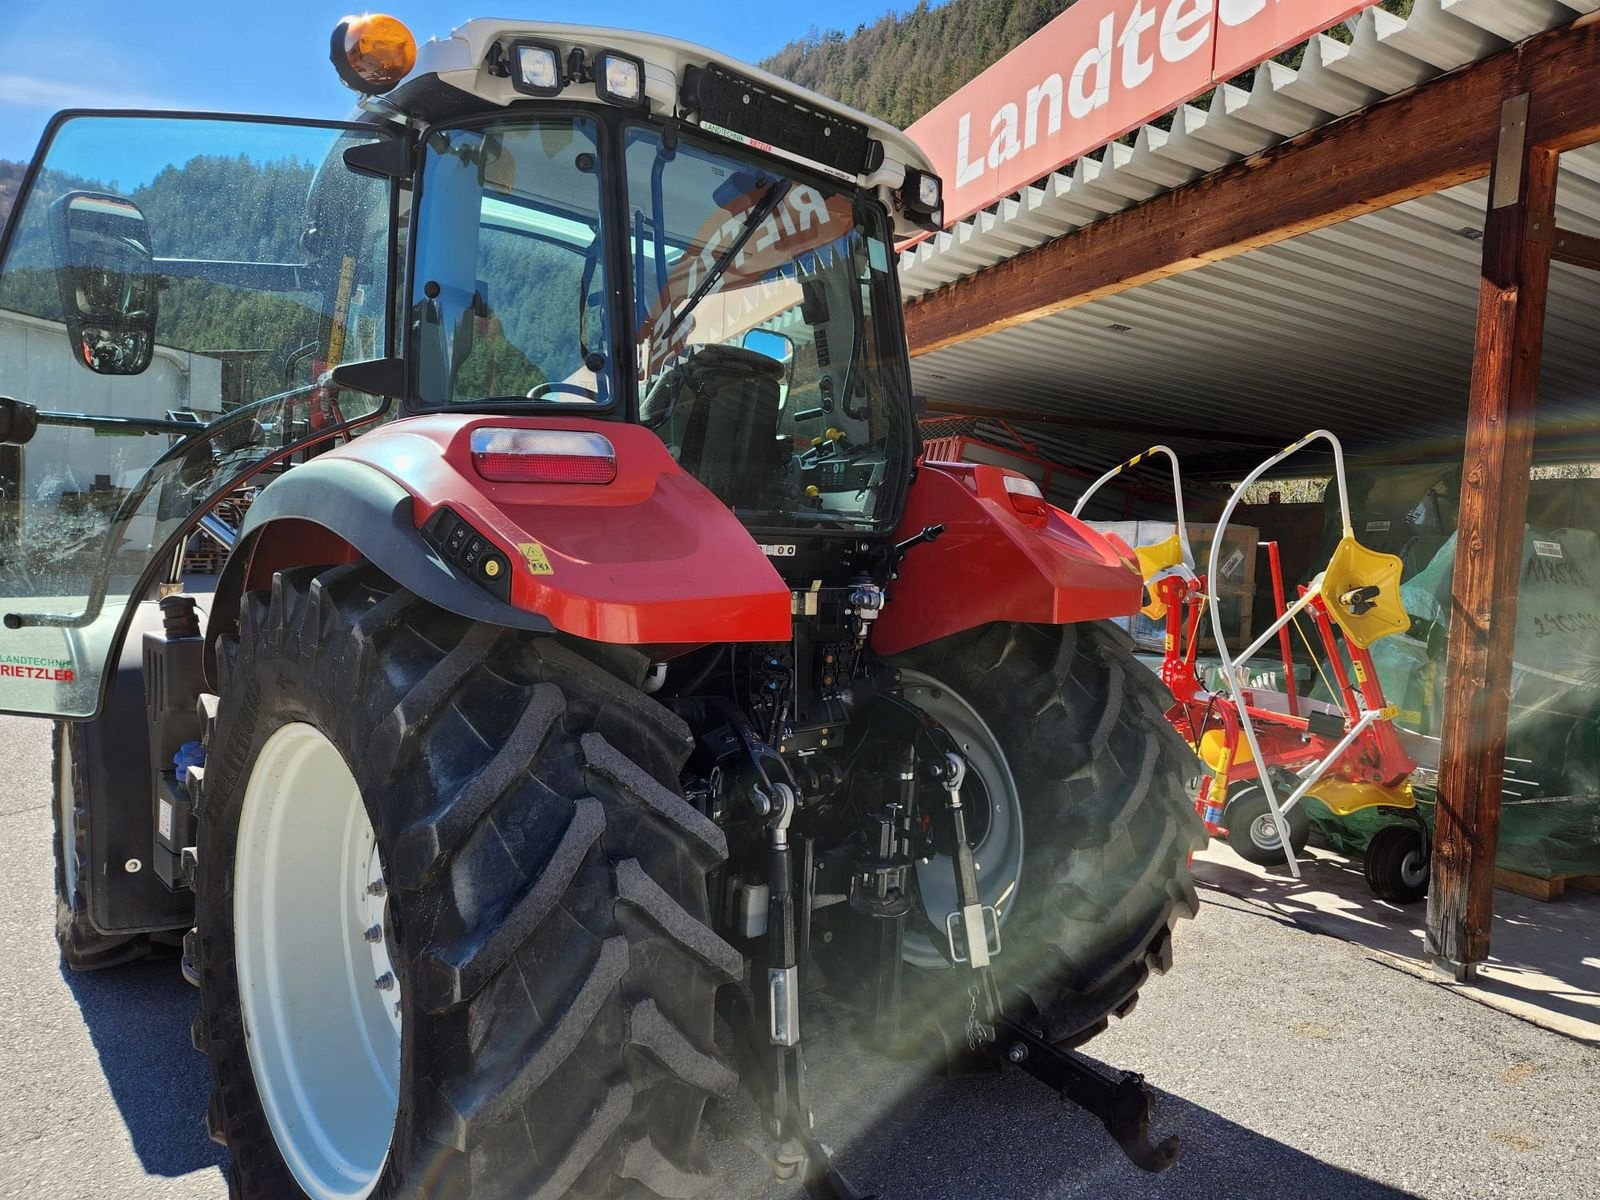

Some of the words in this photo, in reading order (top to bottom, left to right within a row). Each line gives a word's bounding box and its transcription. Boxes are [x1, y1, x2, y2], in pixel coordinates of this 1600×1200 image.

[956, 0, 1281, 189] Landte
[703, 122, 744, 143] LANDTECHNIK
[750, 138, 772, 152] RIETZLER
[0, 664, 74, 682] RIETZLER
